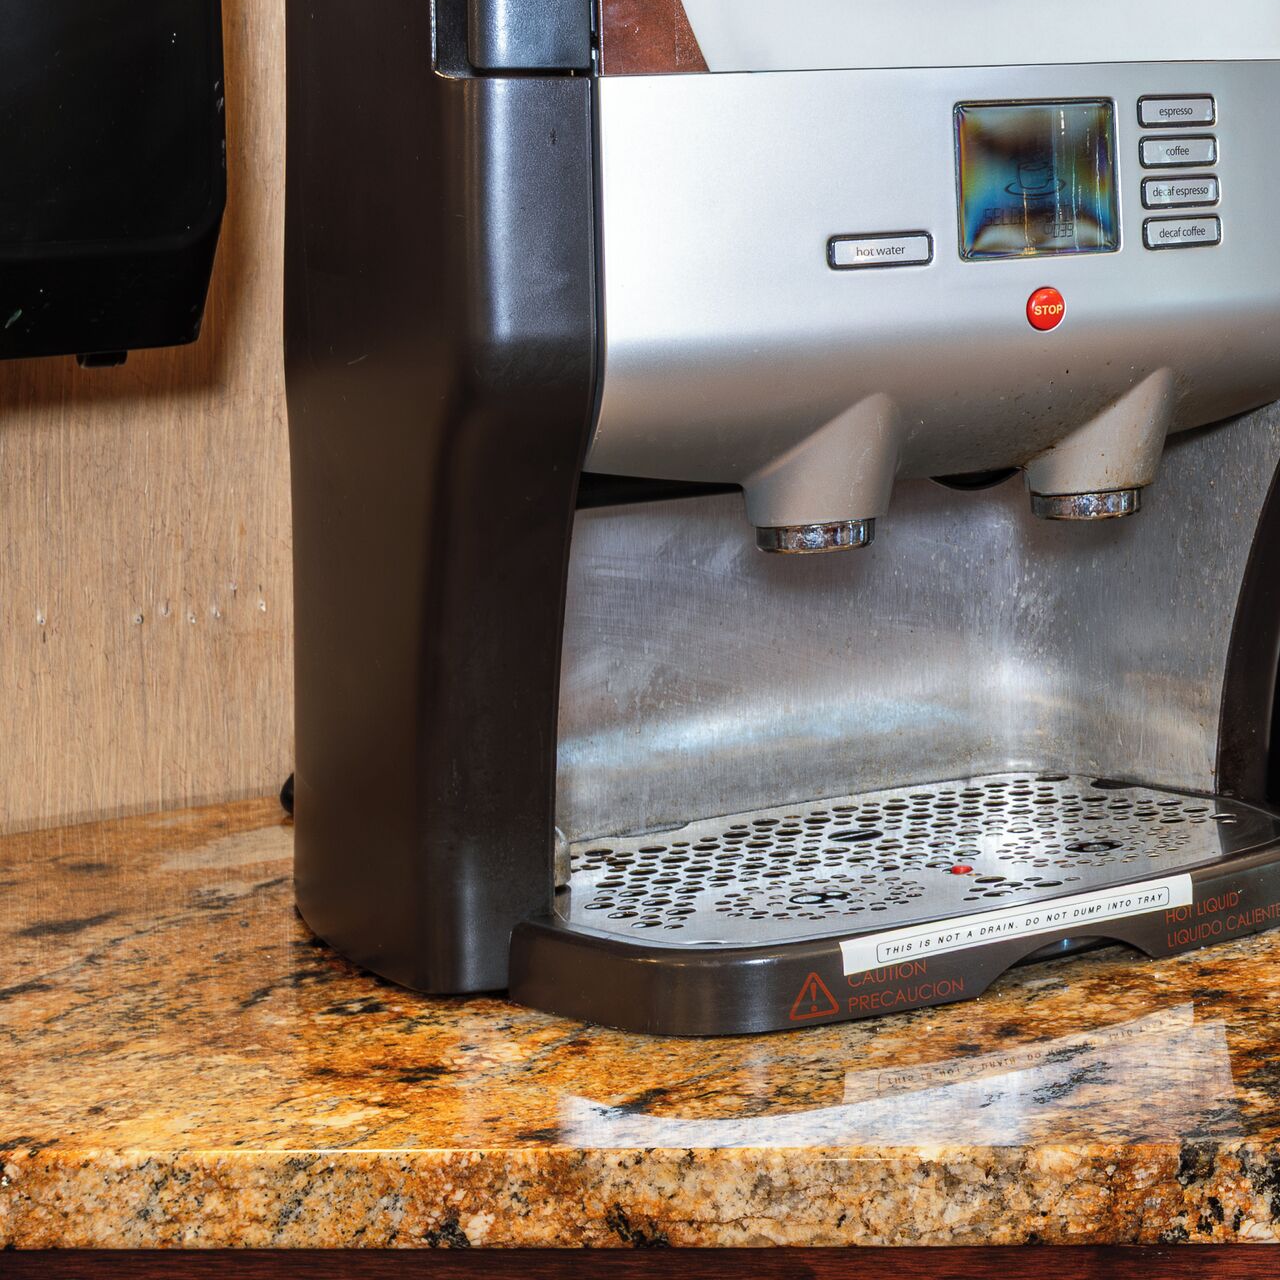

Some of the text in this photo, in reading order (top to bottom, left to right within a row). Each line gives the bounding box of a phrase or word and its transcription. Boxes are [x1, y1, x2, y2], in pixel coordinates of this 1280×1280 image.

[1159, 106, 1193, 117] espresso
[1166, 146, 1190, 156] coffee
[1153, 185, 1209, 199] decaf espresso
[1159, 226, 1206, 238] decaf coffee
[856, 245, 906, 257] hot water
[1034, 304, 1063, 316] STOP
[1197, 892, 1240, 916] LIQUID
[886, 893, 1164, 956] THIS IS NOT A DRAIN. DO NOT DUMP INTO TRAY
[1167, 919, 1223, 948] LIQUIDO
[847, 959, 928, 988] CAUTION
[848, 976, 965, 1013] PRECAUCION
